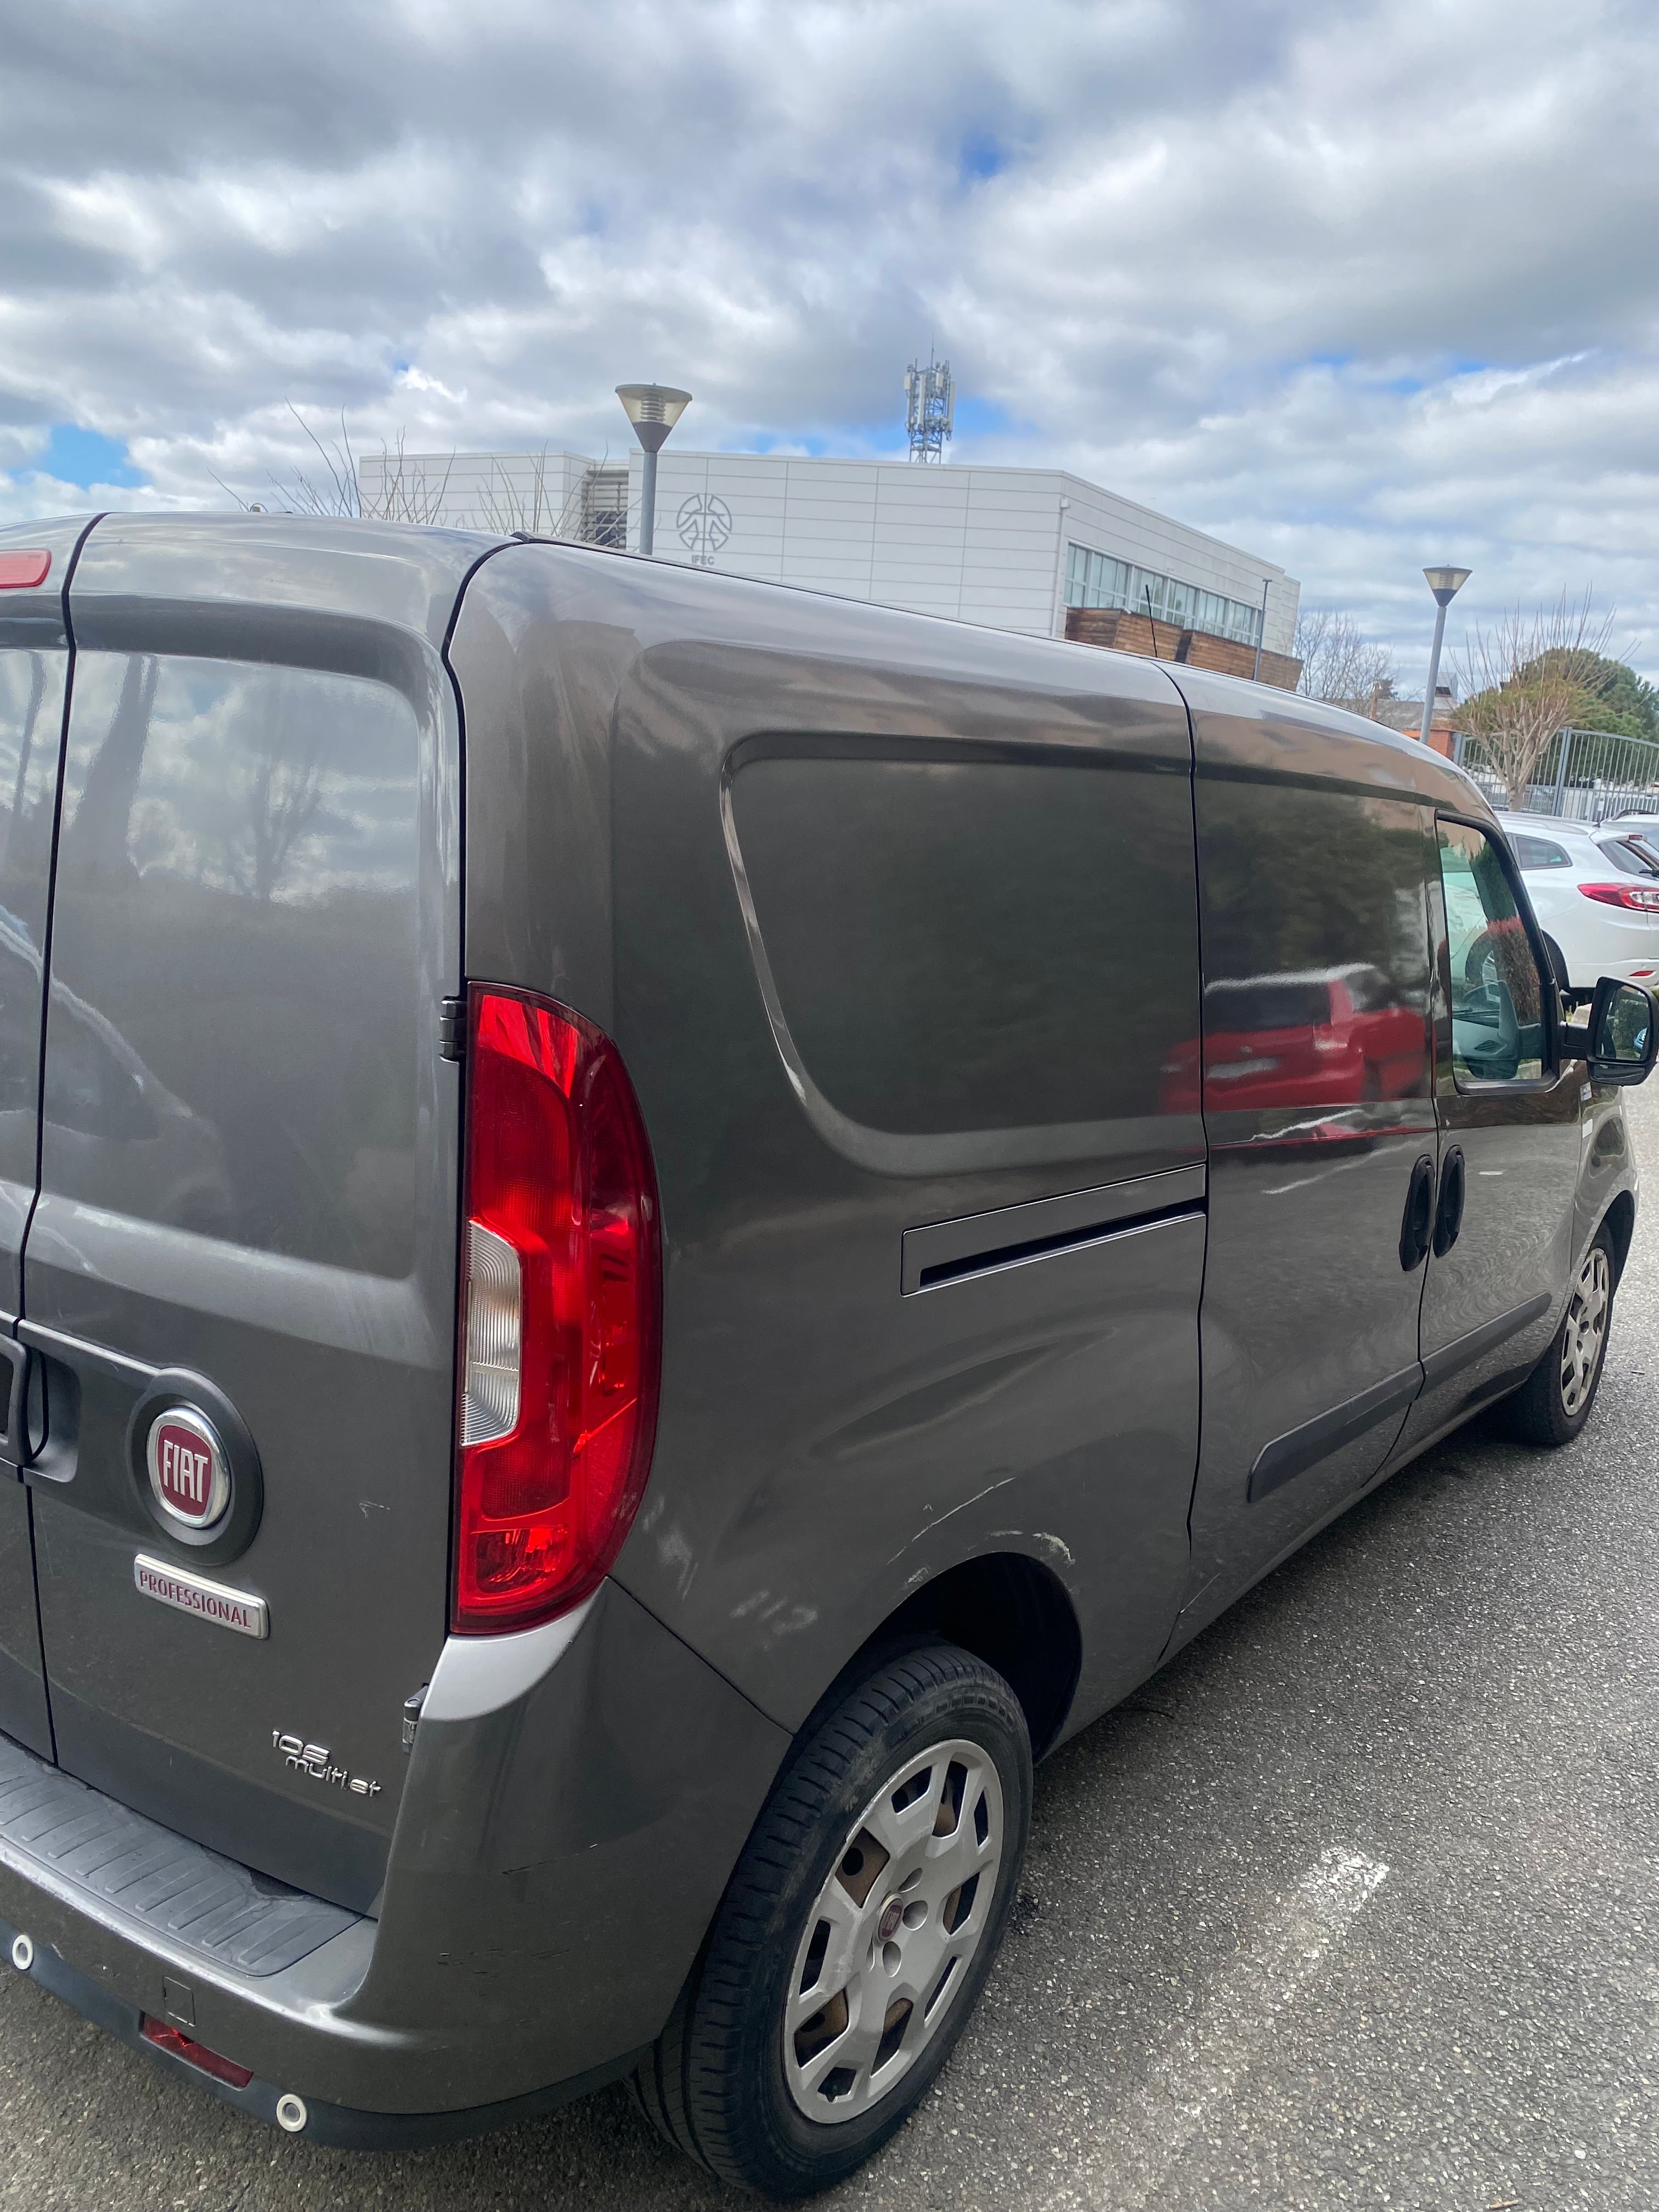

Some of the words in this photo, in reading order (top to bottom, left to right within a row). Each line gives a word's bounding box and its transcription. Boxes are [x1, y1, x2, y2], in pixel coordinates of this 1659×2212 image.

[691, 555, 714, 565] IFEC
[164, 1439, 208, 1503] FIAT
[139, 1570, 251, 1629] PROFESSIONAL
[272, 1730, 329, 1765] 105
[285, 1755, 381, 1797] multiet
